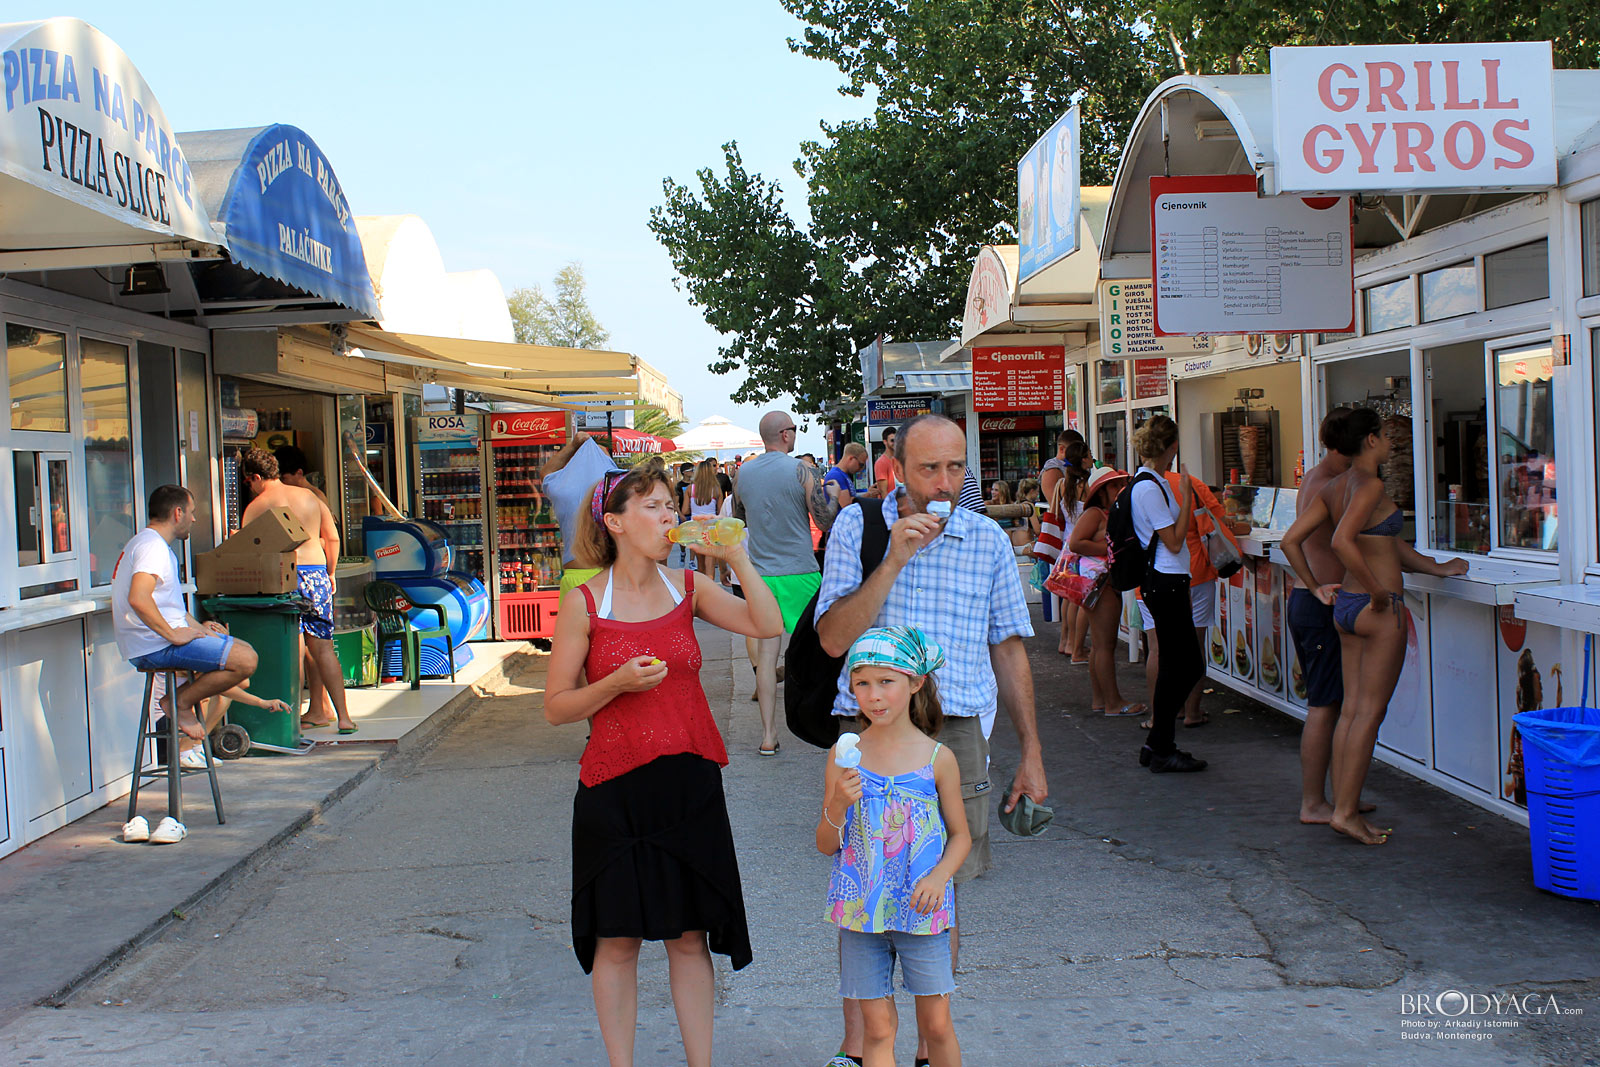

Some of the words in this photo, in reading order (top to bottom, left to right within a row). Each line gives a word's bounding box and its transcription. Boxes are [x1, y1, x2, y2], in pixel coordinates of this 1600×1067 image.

[3, 48, 80, 112] PIZZA
[93, 66, 128, 131] NA
[1318, 59, 1519, 112] GRILL
[1303, 119, 1534, 174] GYROS
[38, 106, 113, 198] PIZZA
[113, 151, 171, 226] SLICE
[256, 139, 293, 194] PIZZA
[297, 141, 313, 178] NA
[1161, 201, 1207, 211] Cjenovnik
[278, 222, 333, 274] PALAČINKE
[1109, 285, 1122, 354] GIROS
[1127, 338, 1157, 346] LIMENKE
[991, 351, 1046, 363] Cjenovnik
[871, 409, 890, 420] MINI
[429, 416, 465, 429] ROSA
[511, 417, 551, 432] Coca-Cola
[981, 417, 1017, 431] Coca-Cola
[376, 546, 400, 558] Frikom
